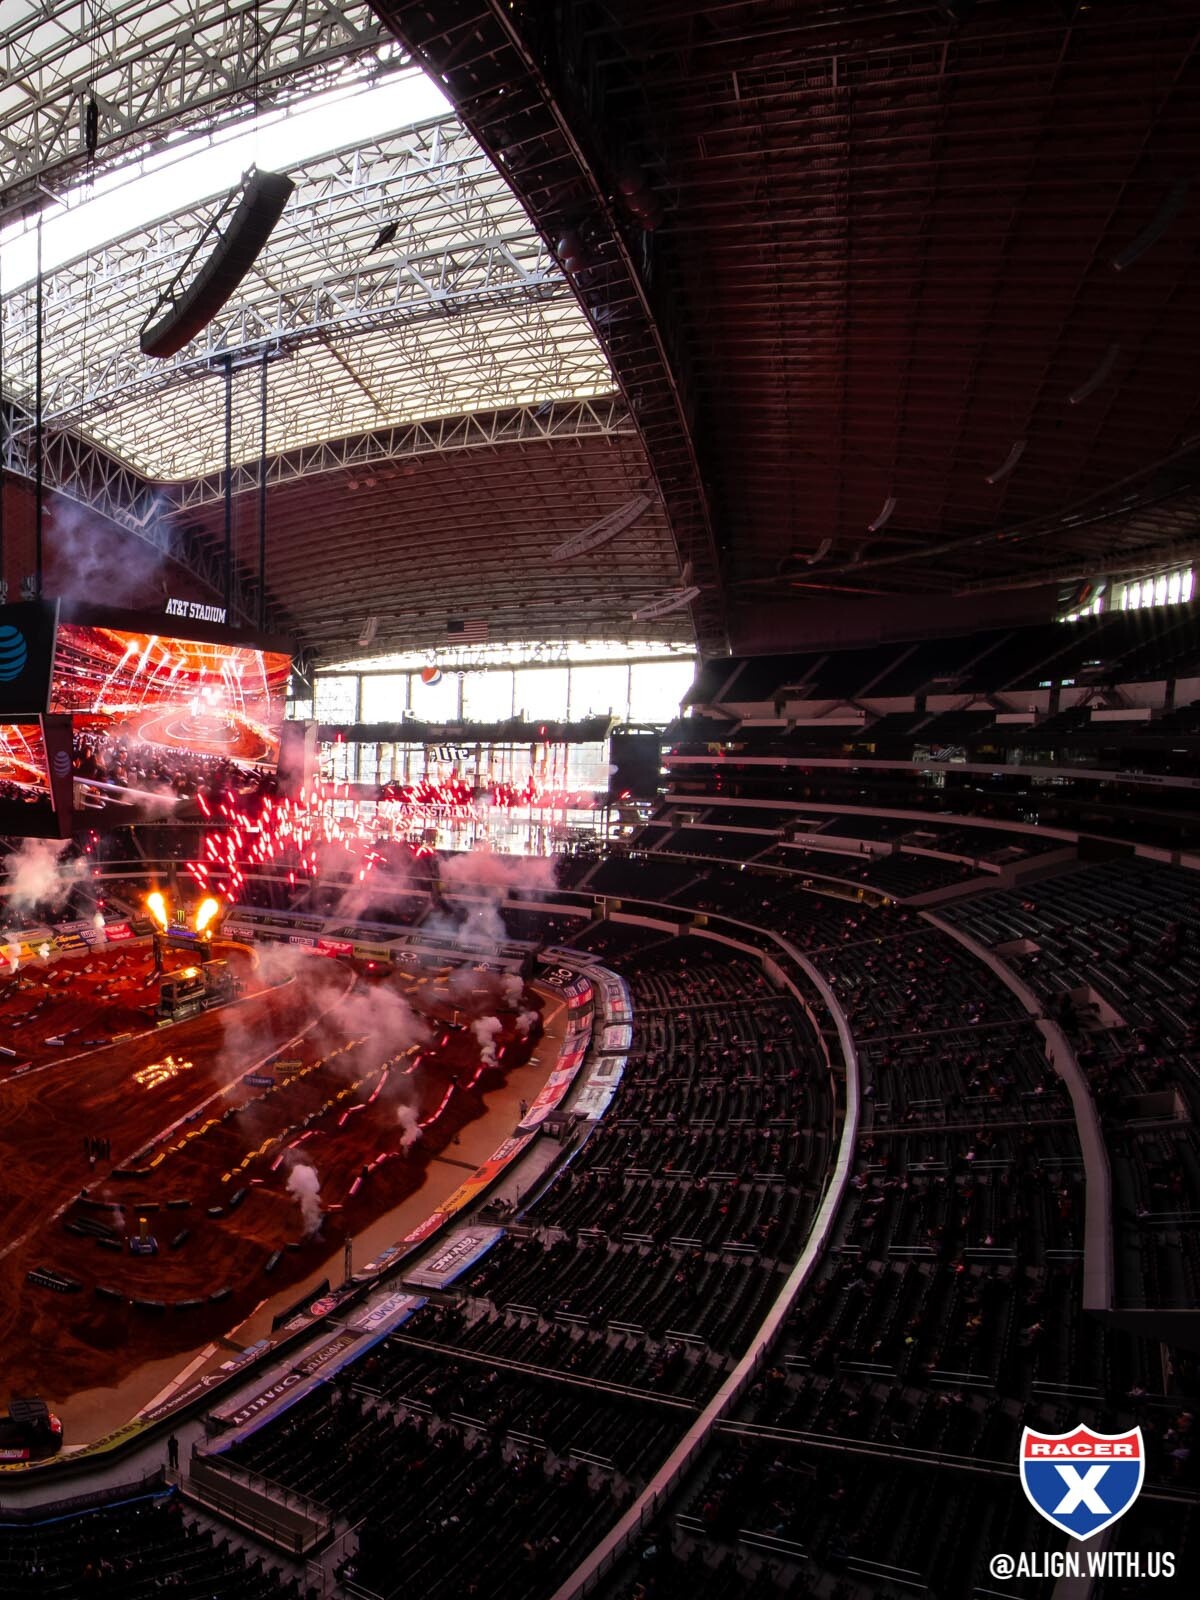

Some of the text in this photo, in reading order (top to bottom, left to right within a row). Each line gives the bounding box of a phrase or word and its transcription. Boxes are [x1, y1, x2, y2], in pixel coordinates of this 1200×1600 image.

[165, 597, 227, 624] AT&T STADIUM
[289, 936, 315, 946] WPS
[302, 1341, 346, 1375] MONSTER
[231, 1383, 286, 1425] OAKLEY
